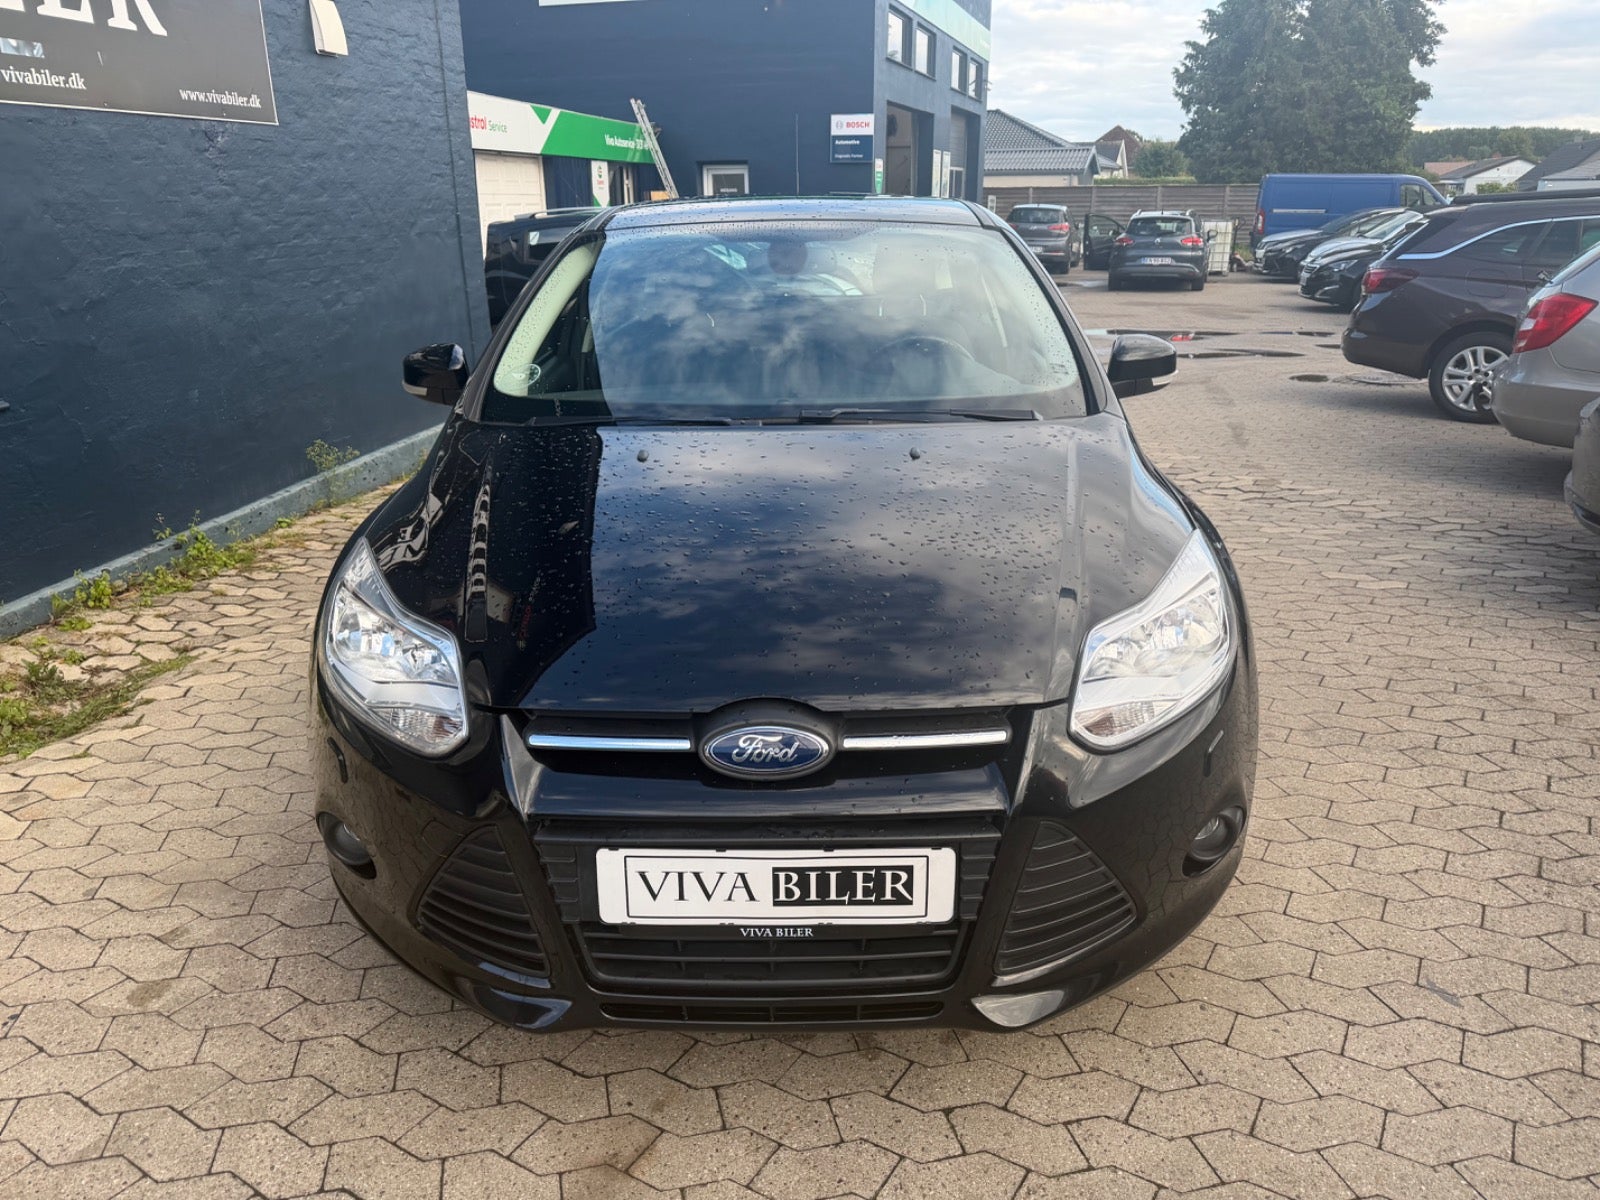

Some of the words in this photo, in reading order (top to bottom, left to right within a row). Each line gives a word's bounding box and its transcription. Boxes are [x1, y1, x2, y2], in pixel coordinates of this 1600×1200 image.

[0, 65, 87, 90] vivabiler.dk
[179, 89, 262, 108] www.vivabiler.dk
[469, 115, 487, 130] strol
[846, 121, 871, 129] BOSCH
[732, 734, 800, 763] Ford
[635, 870, 760, 902] VIVA
[773, 868, 913, 905] BILER
[740, 928, 773, 937] VIVA
[776, 928, 814, 937] BILER
